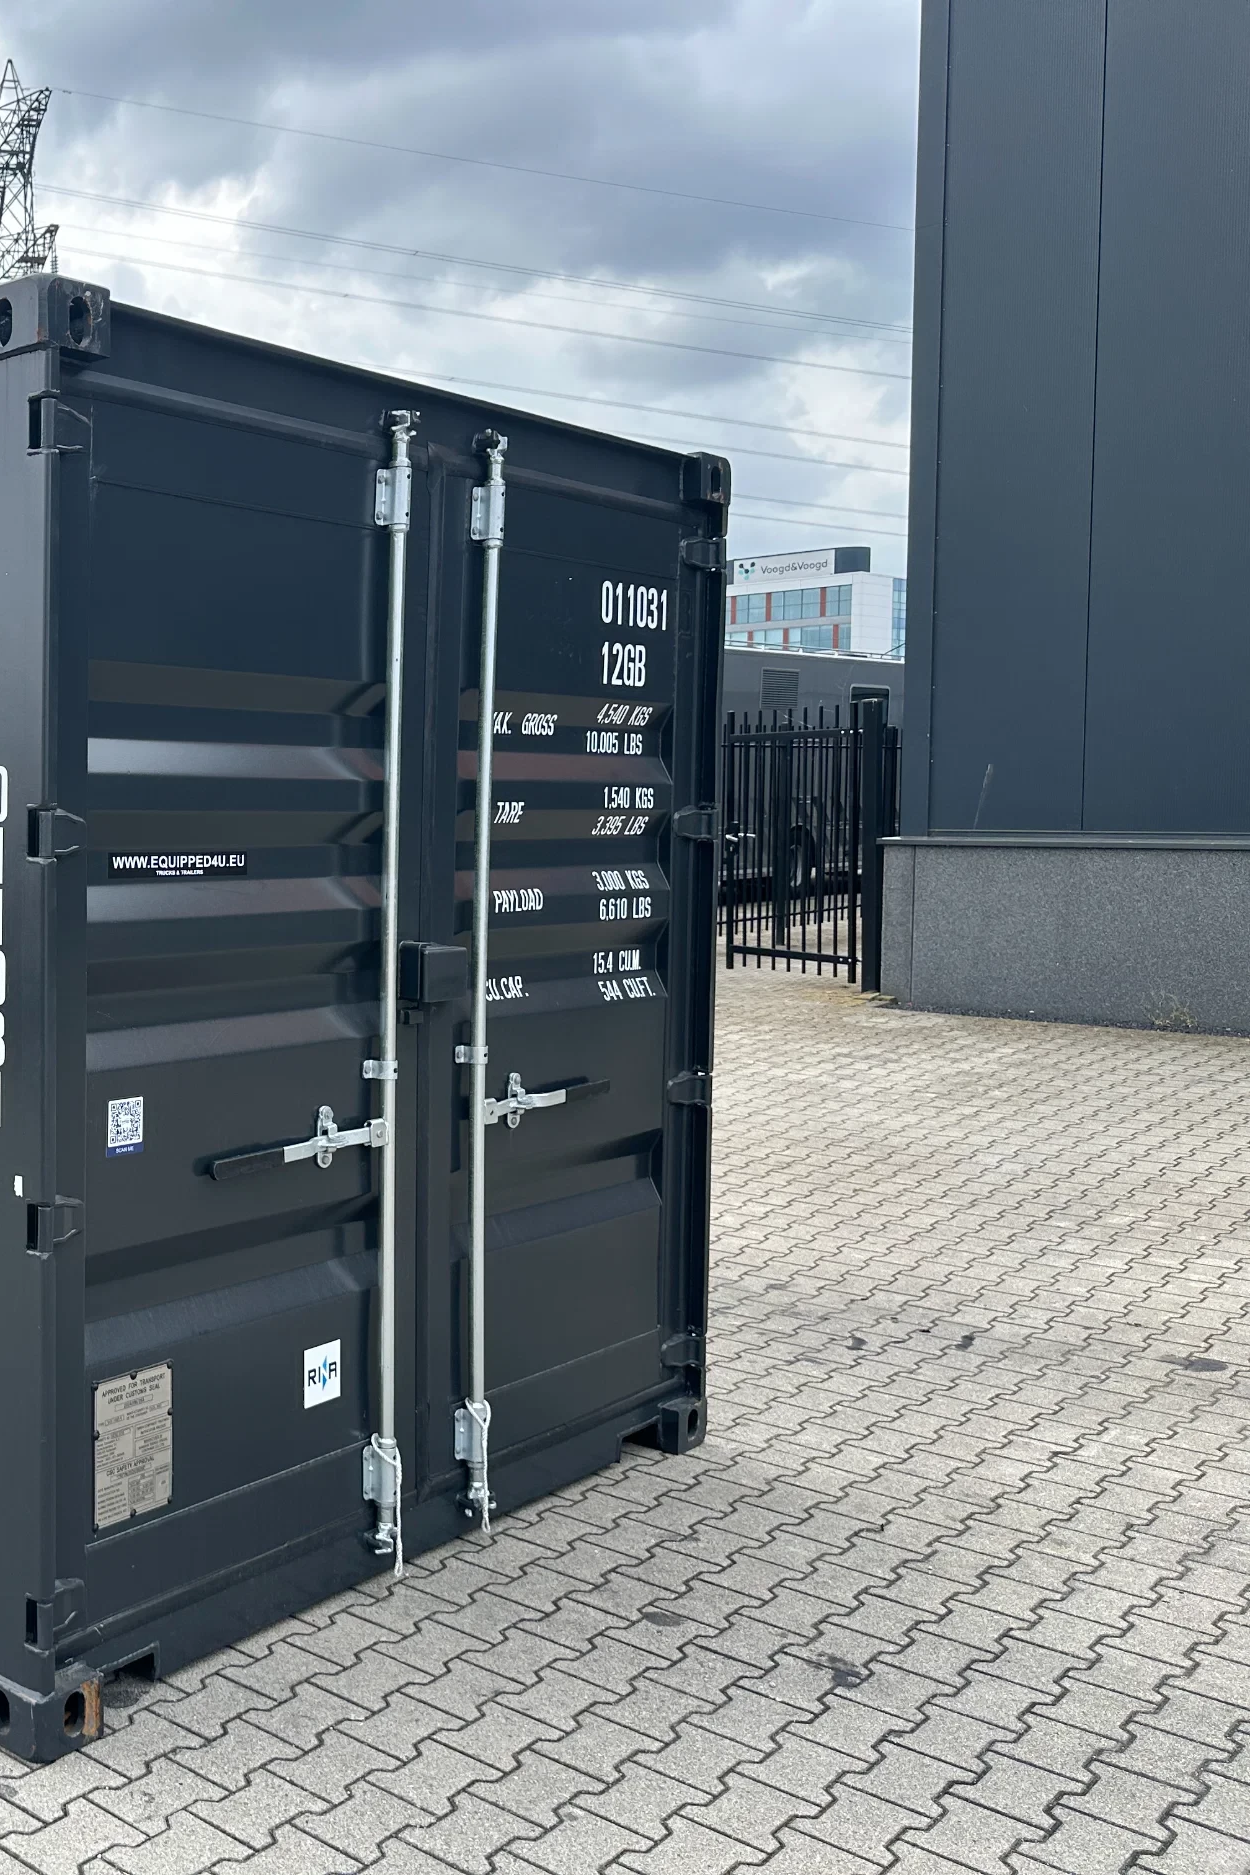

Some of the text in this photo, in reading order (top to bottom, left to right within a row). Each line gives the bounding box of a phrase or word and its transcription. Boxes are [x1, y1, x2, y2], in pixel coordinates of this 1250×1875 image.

[760, 559, 828, 575] Voogd&Voogd
[601, 580, 668, 631] 011031
[601, 641, 647, 687] 12GB
[493, 711, 558, 736] AX. GROSS
[596, 703, 653, 727] 4,540 KGS
[586, 730, 643, 755] 10,005 LBS
[603, 786, 654, 810] 1,540 KGS
[493, 801, 525, 824] TARE
[591, 815, 649, 837] 3,395 LBS
[112, 854, 245, 869] WWW.EQUIPPED4U.EU
[592, 870, 650, 891] 3,000 KGS
[493, 888, 544, 914] PAYLOAD
[599, 897, 652, 921] 6,610 LBS
[593, 949, 642, 974] 15.4 CU.M.
[597, 979, 624, 1001] 544
[101, 1372, 166, 1398] APPROVED FOR TRANSPORT
[108, 1394, 124, 1405] UNDER
[125, 1386, 147, 1399] CUSTOMS
[148, 1383, 161, 1392] SEAL
[116, 1463, 132, 1473] SAFETY
